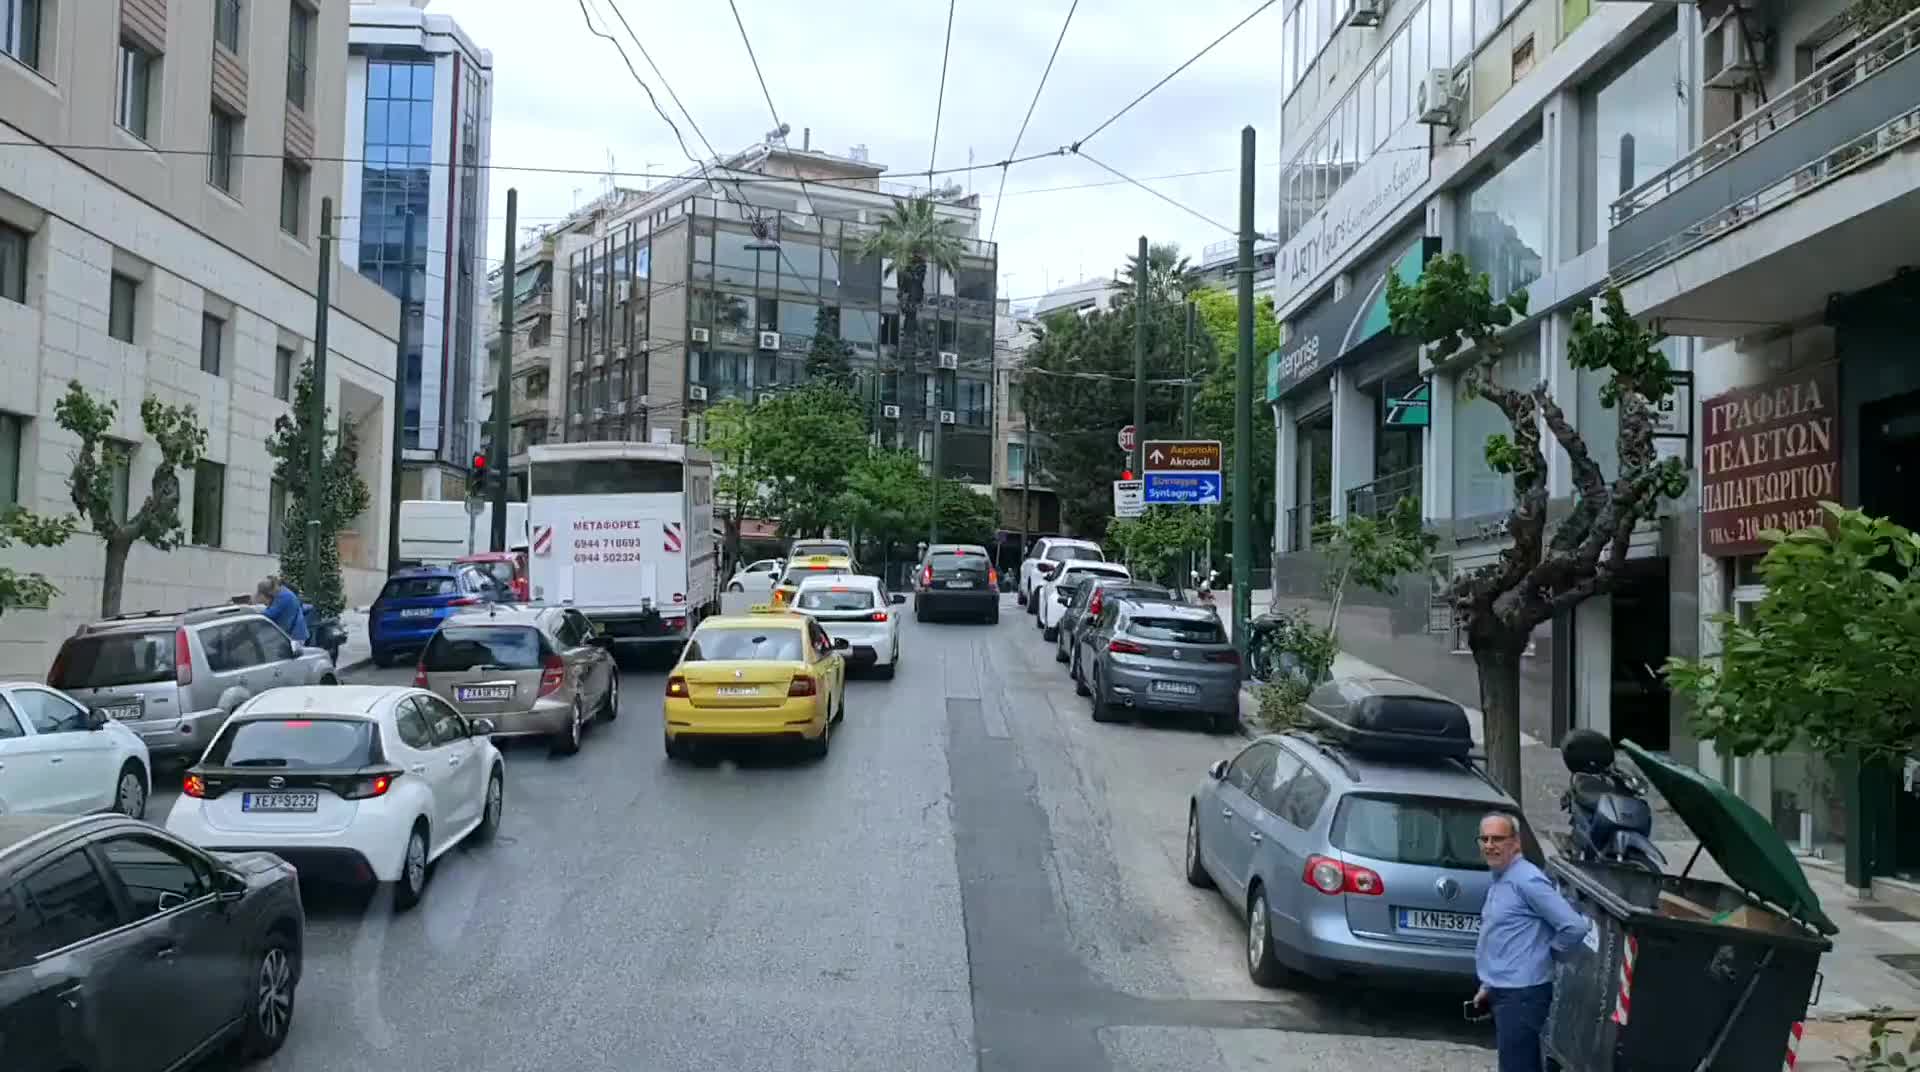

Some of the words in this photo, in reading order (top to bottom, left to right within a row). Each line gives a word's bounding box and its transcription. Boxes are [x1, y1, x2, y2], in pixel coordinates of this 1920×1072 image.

[1711, 378, 1825, 436] ΓΡΑΦΕΙΑ
[1169, 456, 1211, 468] Akropoli
[1704, 416, 1833, 475] ΤΕΛΕΤΩΝ
[1703, 461, 1837, 513] ΠΑΠΑΓΕΩΡΓΙΟΥ
[573, 519, 641, 531] ΜΕΤΑΦΟΡΕΣ
